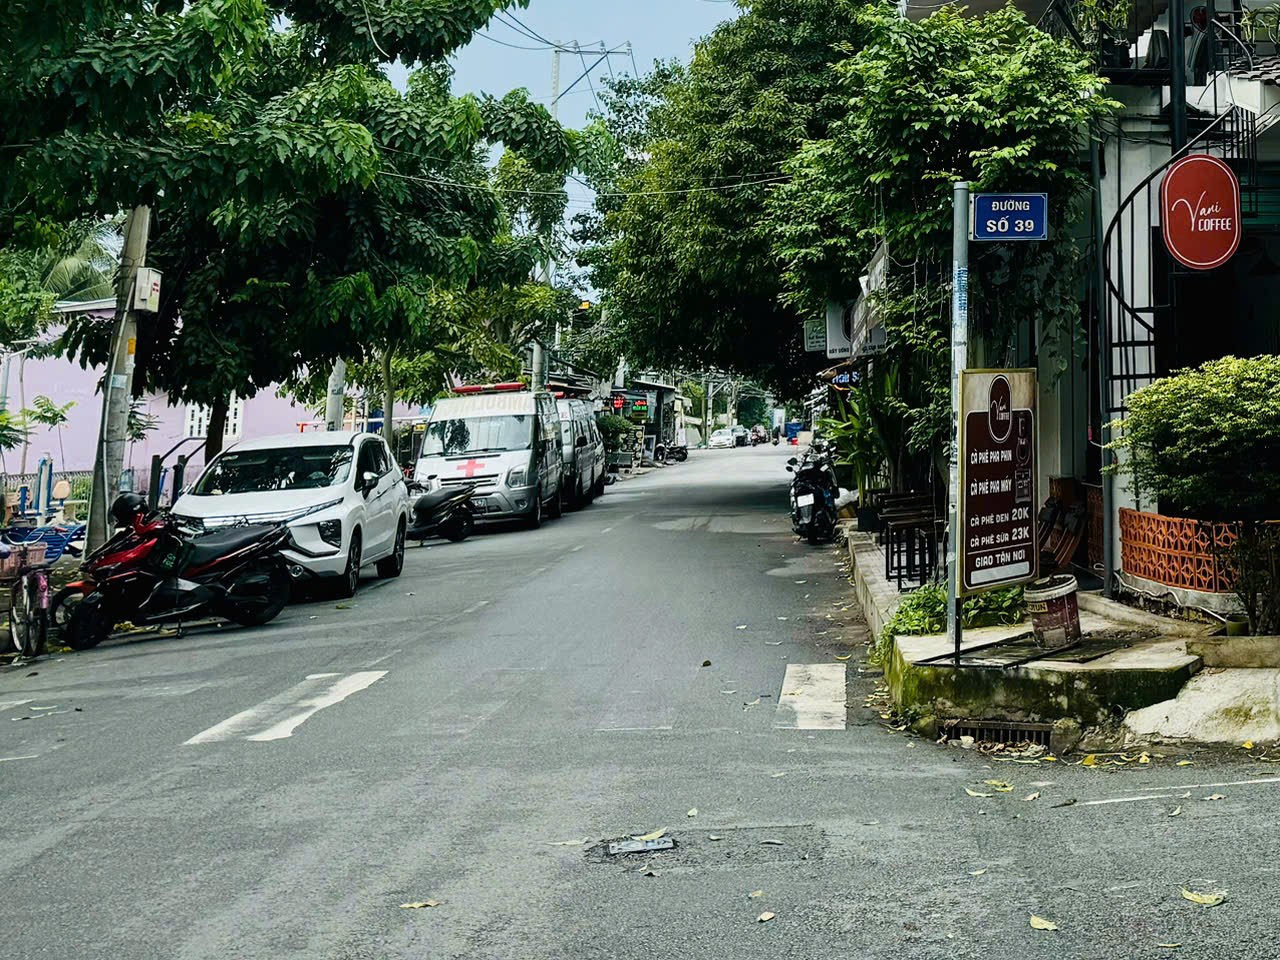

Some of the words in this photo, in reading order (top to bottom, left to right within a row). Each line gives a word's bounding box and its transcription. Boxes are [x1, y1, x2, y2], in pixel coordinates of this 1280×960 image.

[991, 199, 1030, 212] ĐƯỜNG
[986, 215, 1010, 233] SỐ
[1014, 219, 1035, 233] 39
[1198, 217, 1232, 232] COFFEE
[970, 448, 978, 465] CÀ
[970, 478, 978, 496] CÀ
[970, 514, 980, 527] CÀ
[1011, 507, 1030, 521] 20K
[970, 534, 980, 548] CÀ
[1011, 526, 1030, 541] 23K
[975, 555, 993, 568] GIAO
